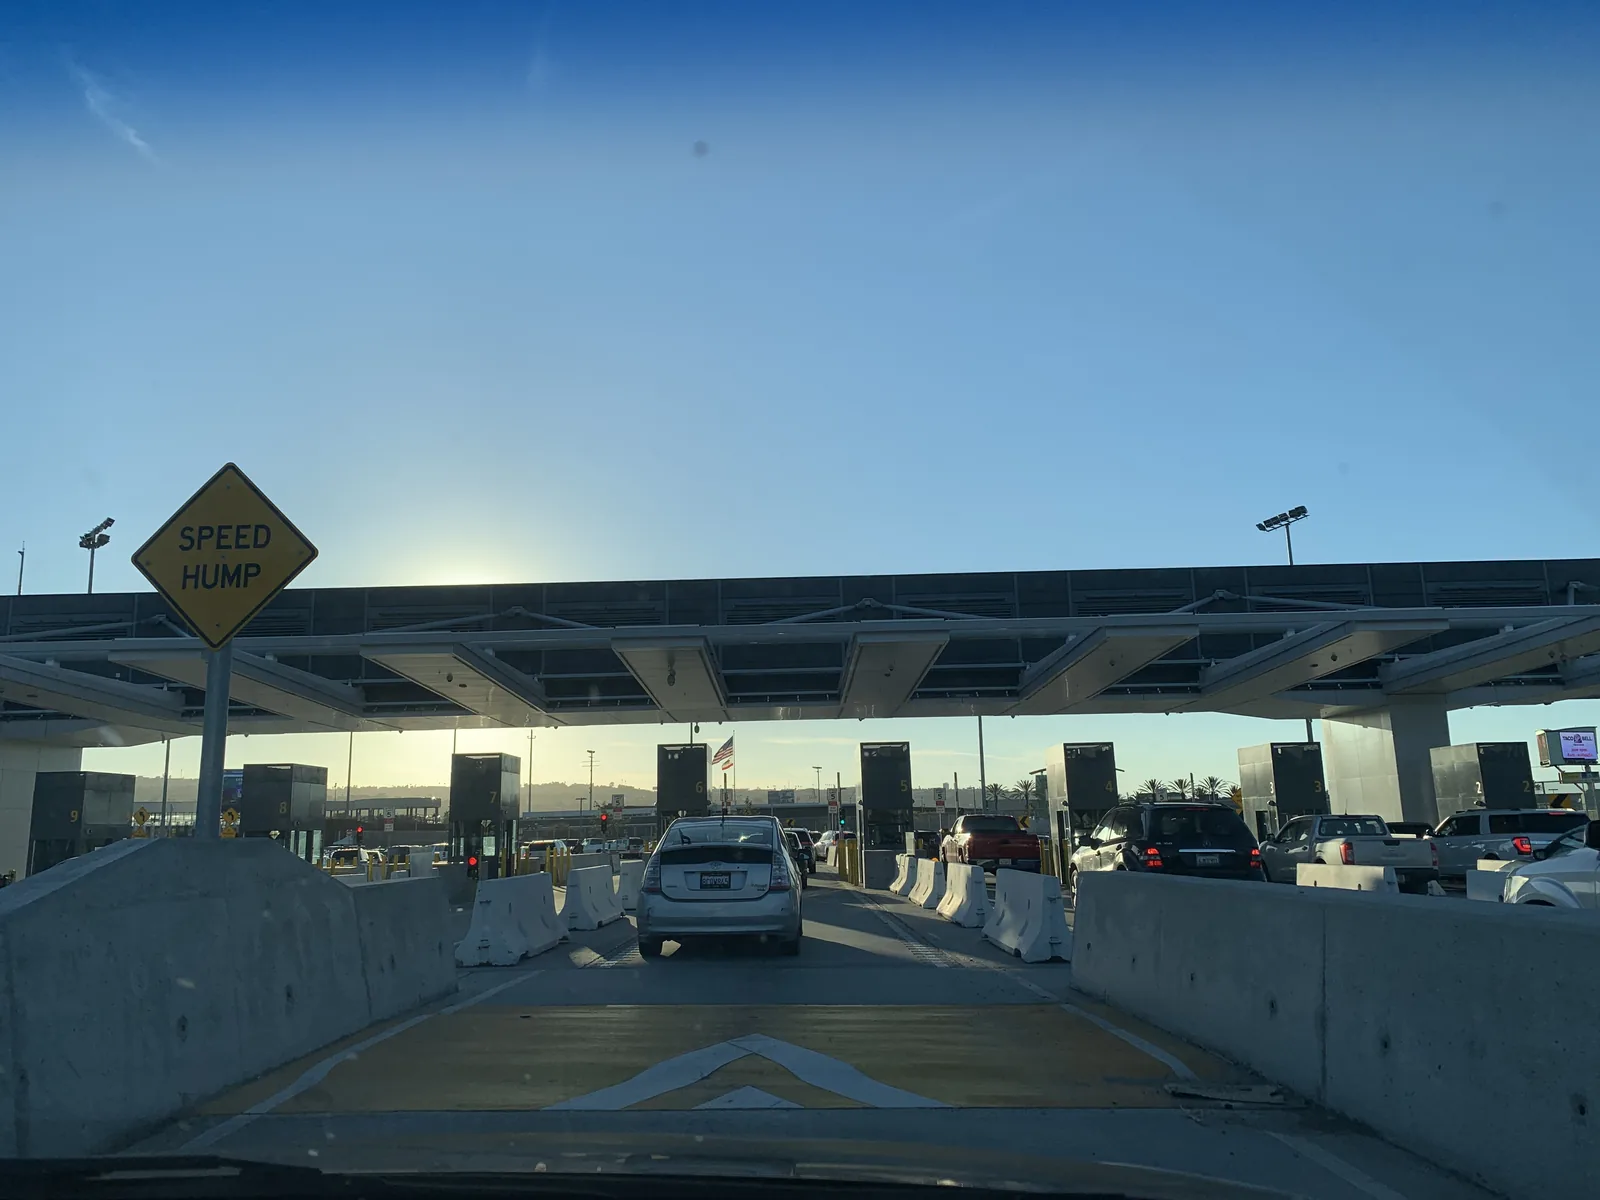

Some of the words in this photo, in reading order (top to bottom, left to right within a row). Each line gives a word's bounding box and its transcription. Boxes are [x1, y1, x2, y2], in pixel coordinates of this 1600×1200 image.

[178, 524, 271, 552] SPEED
[181, 563, 261, 590] HUMP
[695, 780, 703, 794] 6
[900, 779, 908, 793] 5
[1105, 780, 1113, 793] 4
[1269, 781, 1274, 794] 3
[1314, 780, 1322, 793] 3
[1475, 781, 1482, 794] 2
[1522, 780, 1531, 793] 2
[489, 791, 498, 805] 7
[279, 801, 287, 814] 8
[70, 810, 78, 823] 9
